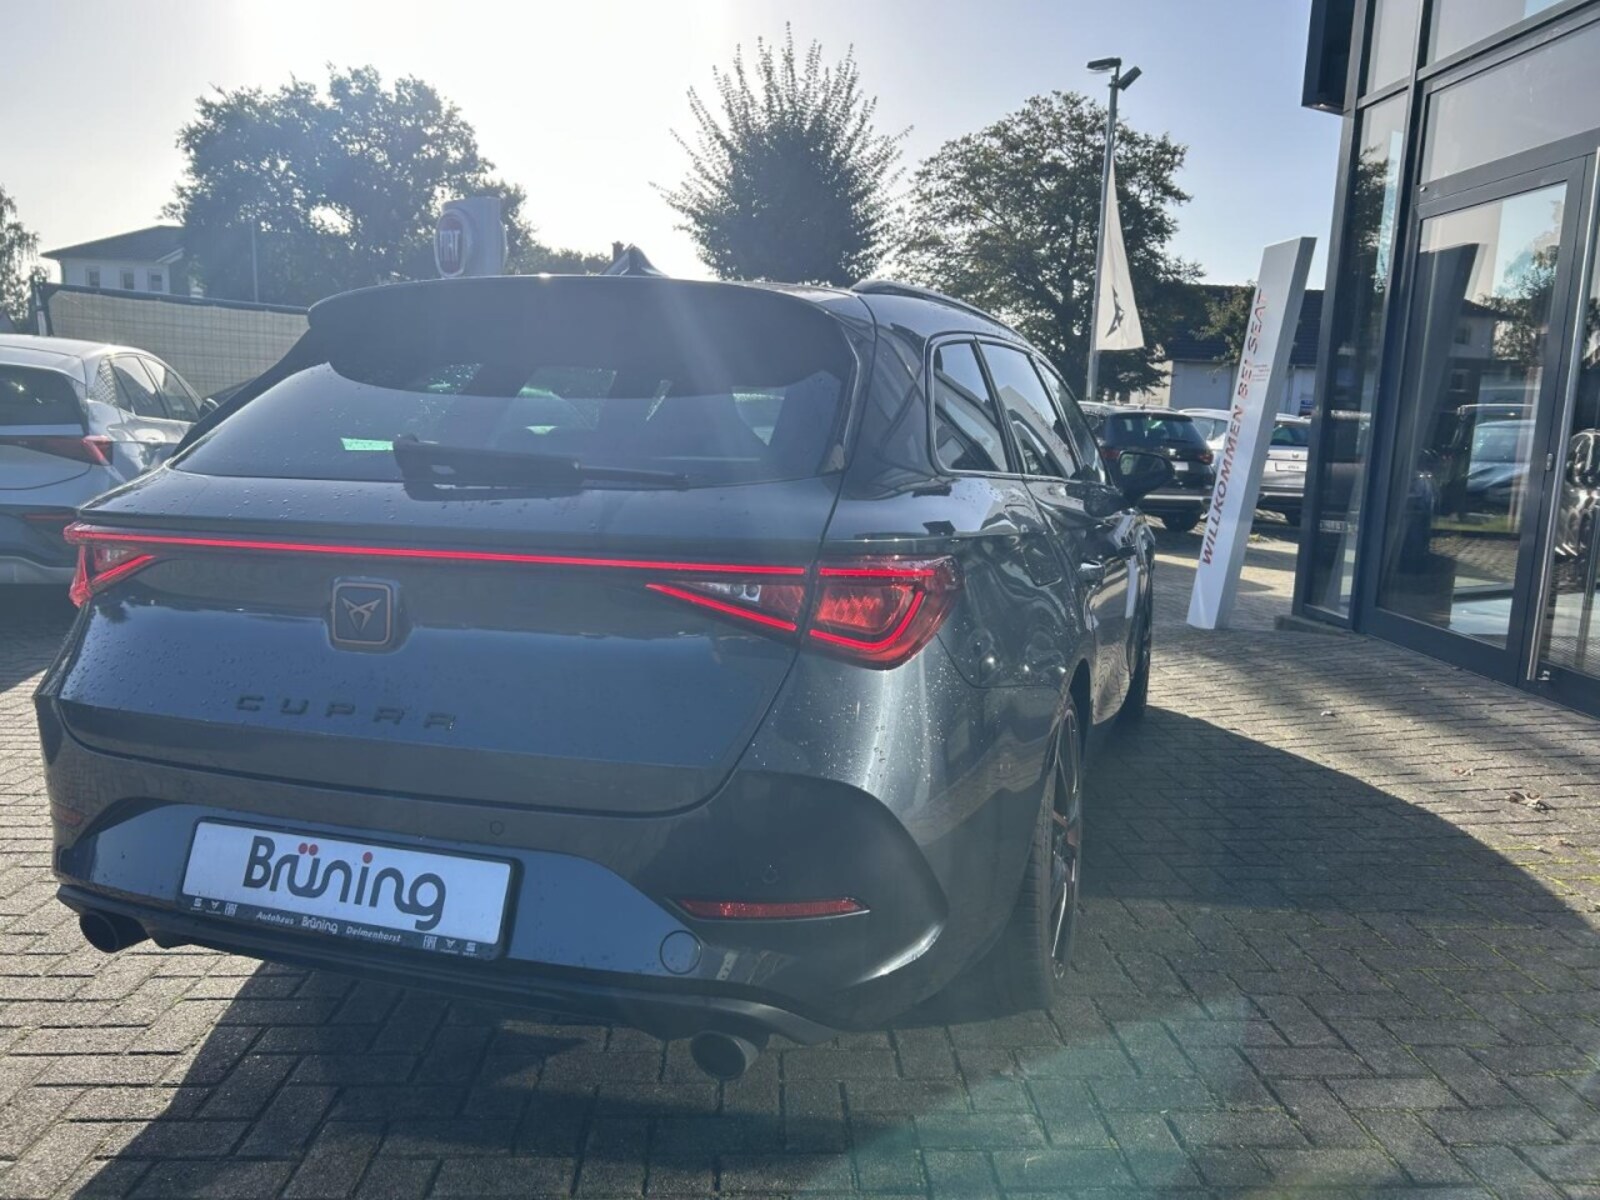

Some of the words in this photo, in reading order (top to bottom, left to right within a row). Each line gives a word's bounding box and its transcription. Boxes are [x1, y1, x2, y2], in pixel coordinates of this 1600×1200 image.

[1202, 404, 1244, 565] WILLKOMMEN
[1237, 359, 1253, 396] BEI
[1247, 288, 1266, 355] SEAT
[236, 694, 456, 731] CUPRA
[243, 835, 446, 931] Brüning
[256, 911, 294, 925] Autohaus
[301, 916, 338, 935] Brüning
[346, 926, 402, 943] Delmenhorst
